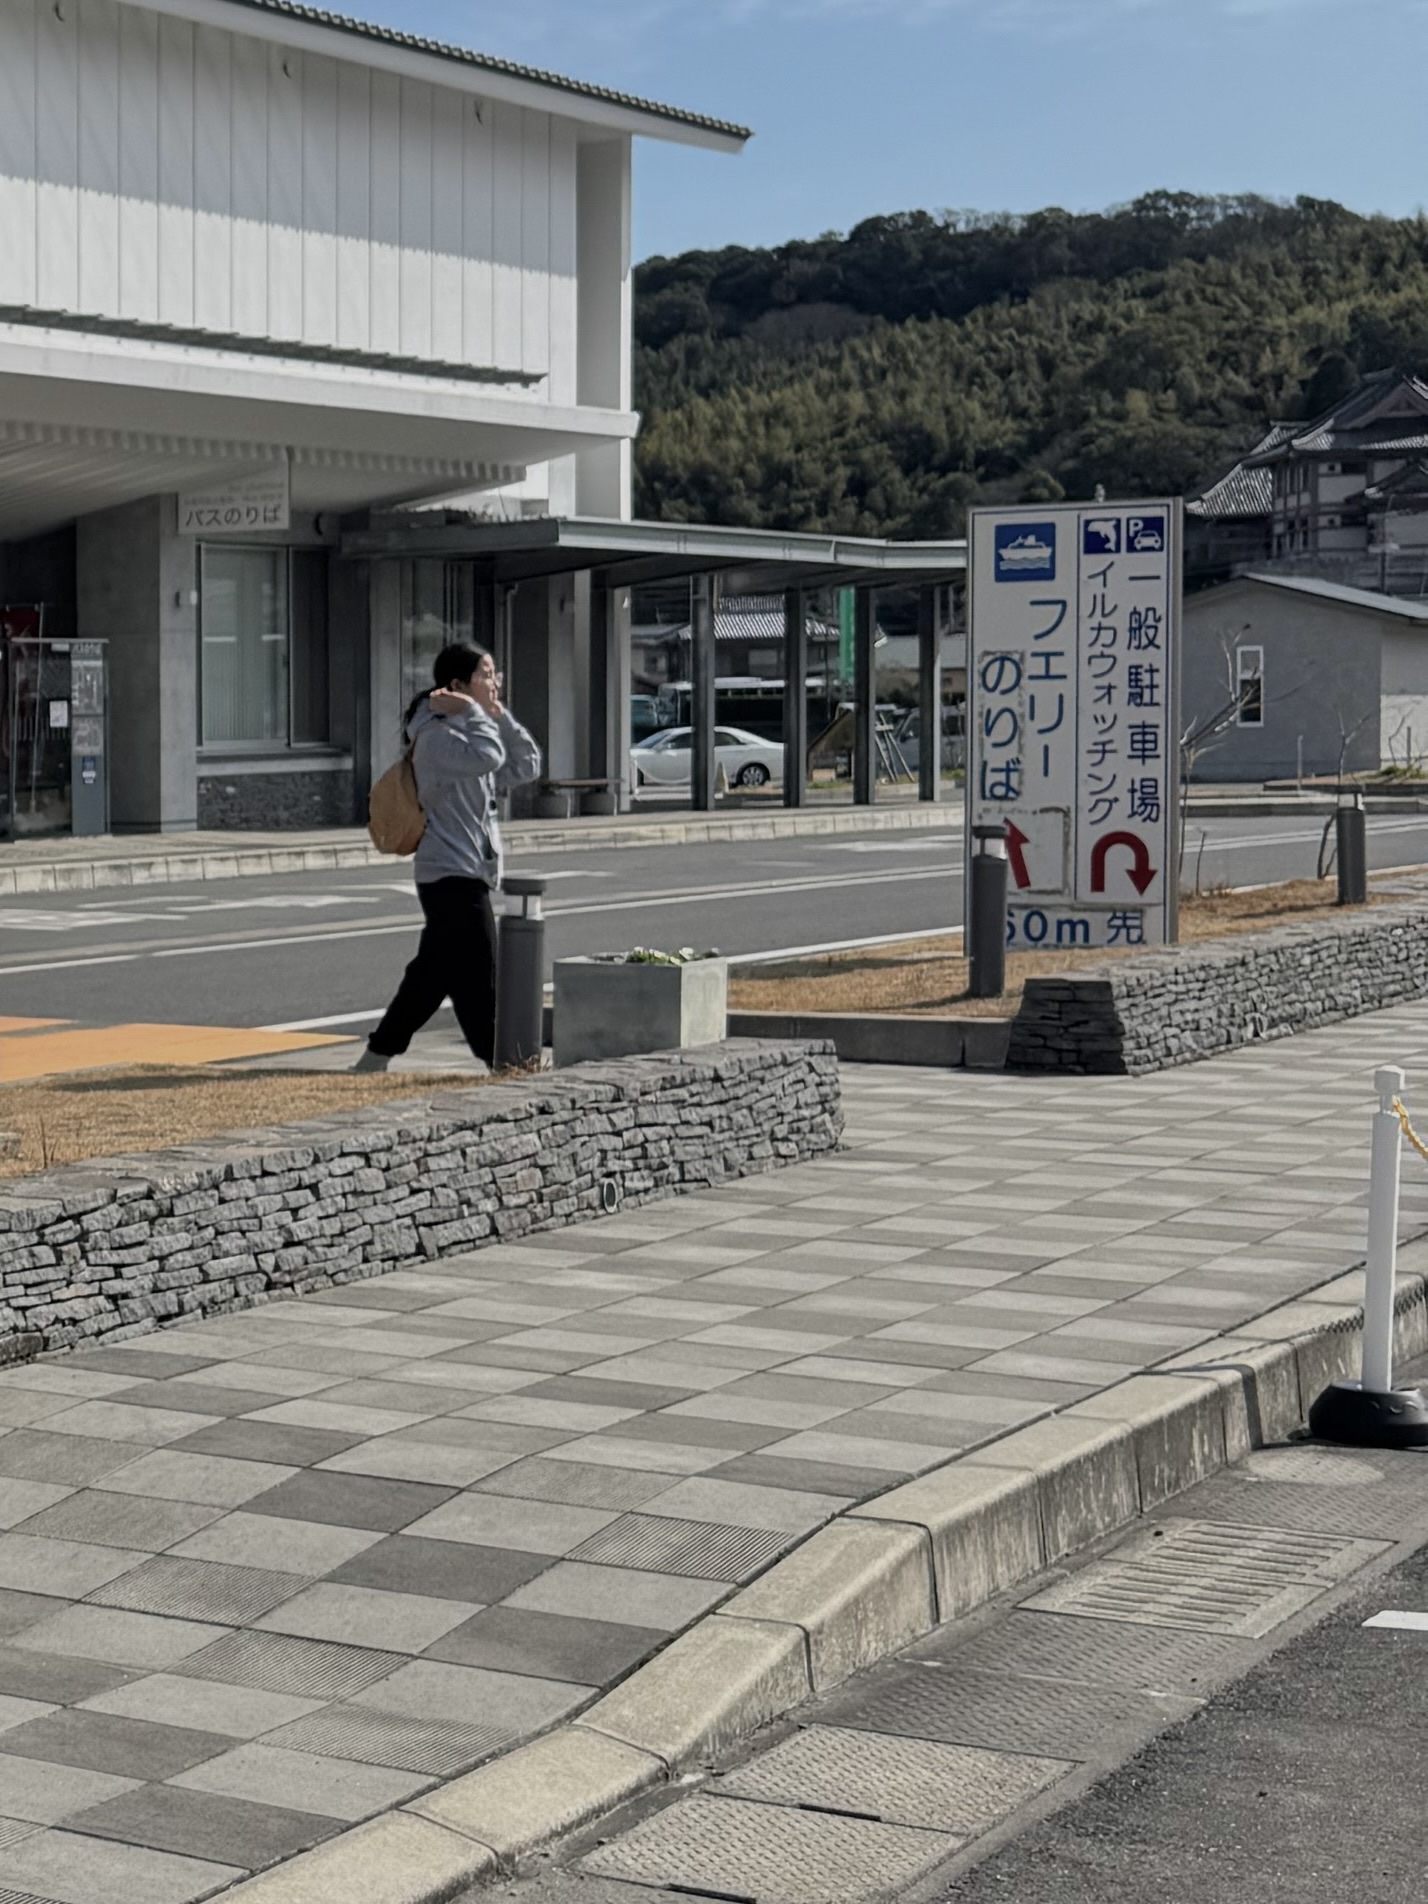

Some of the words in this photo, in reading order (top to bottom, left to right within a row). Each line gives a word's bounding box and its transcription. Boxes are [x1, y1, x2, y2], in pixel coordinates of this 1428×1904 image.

[185, 504, 282, 527] バスのりば
[1128, 518, 1144, 537] P
[980, 655, 1023, 801] のりば
[1085, 560, 1120, 826] イルカウォッチング
[1126, 573, 1163, 824] 一般駐車場
